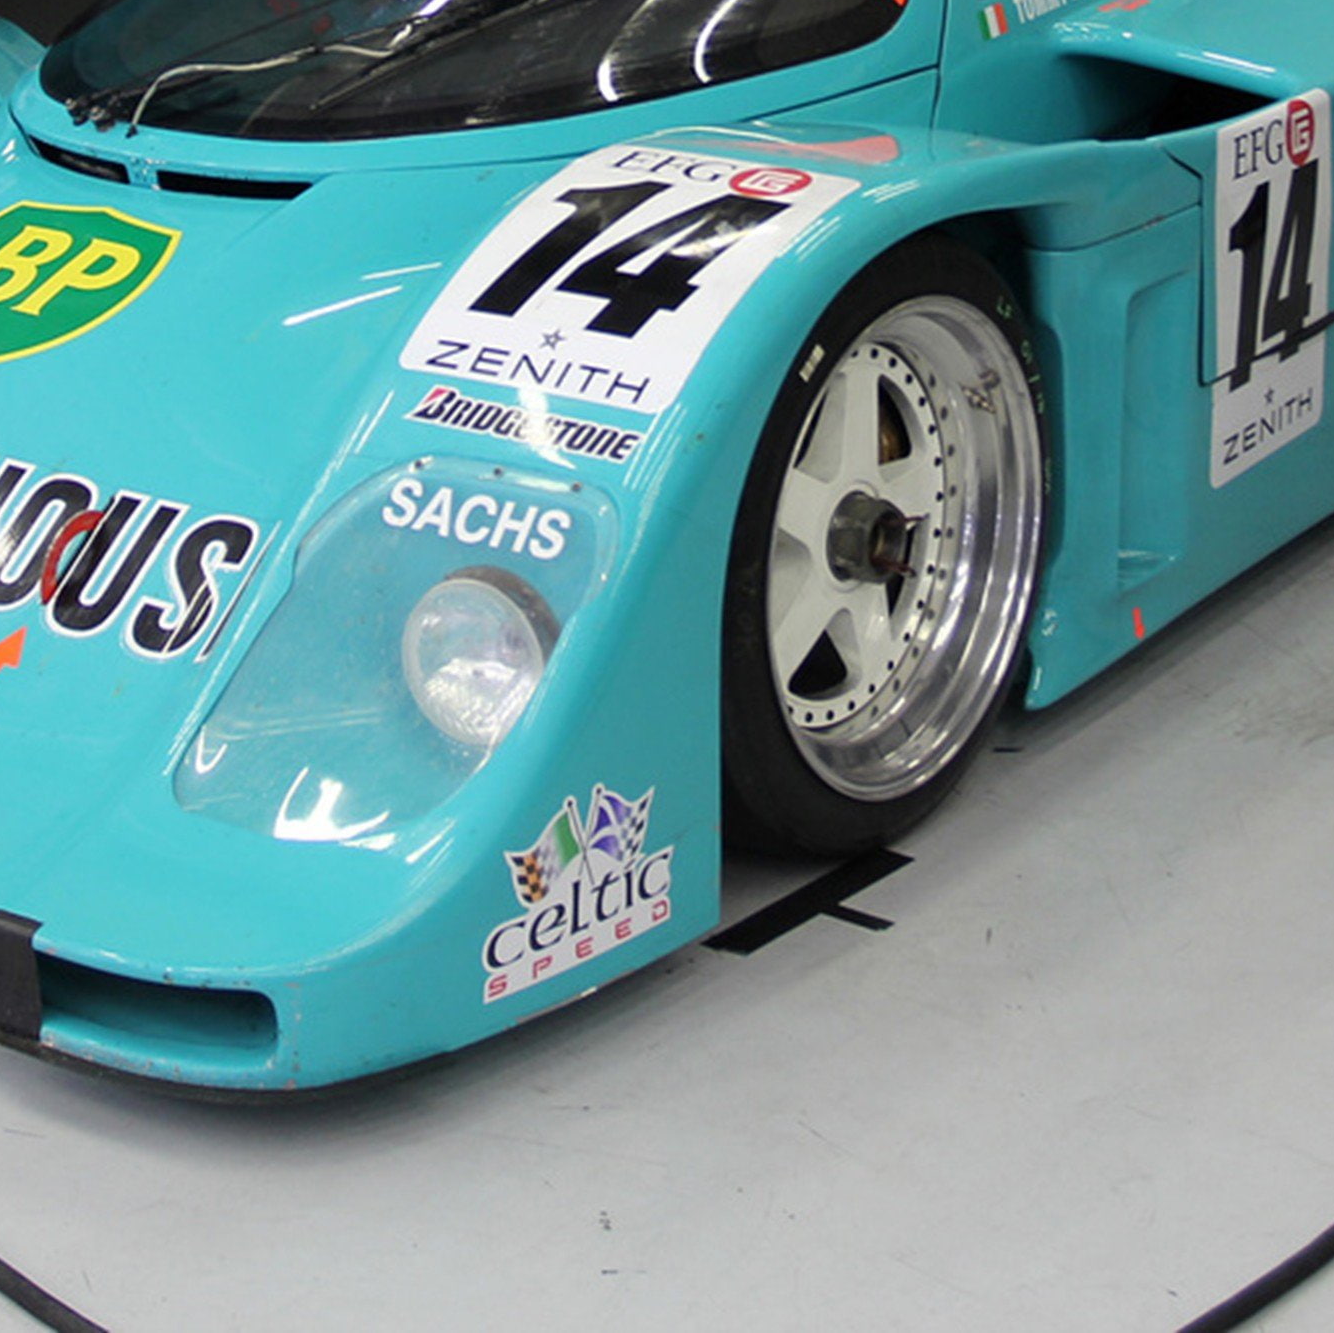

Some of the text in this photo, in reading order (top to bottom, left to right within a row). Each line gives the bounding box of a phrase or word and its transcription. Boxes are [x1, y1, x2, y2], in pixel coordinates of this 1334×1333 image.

[613, 150, 737, 183] EFG
[1232, 119, 1285, 180] EFG
[468, 180, 793, 339] 14
[1229, 157, 1319, 393] 14
[425, 339, 651, 405] ZENITH
[1223, 387, 1314, 465] ZENITH
[382, 477, 571, 560] SACHS
[486, 852, 671, 970] celtic
[487, 899, 670, 999] SPEED
